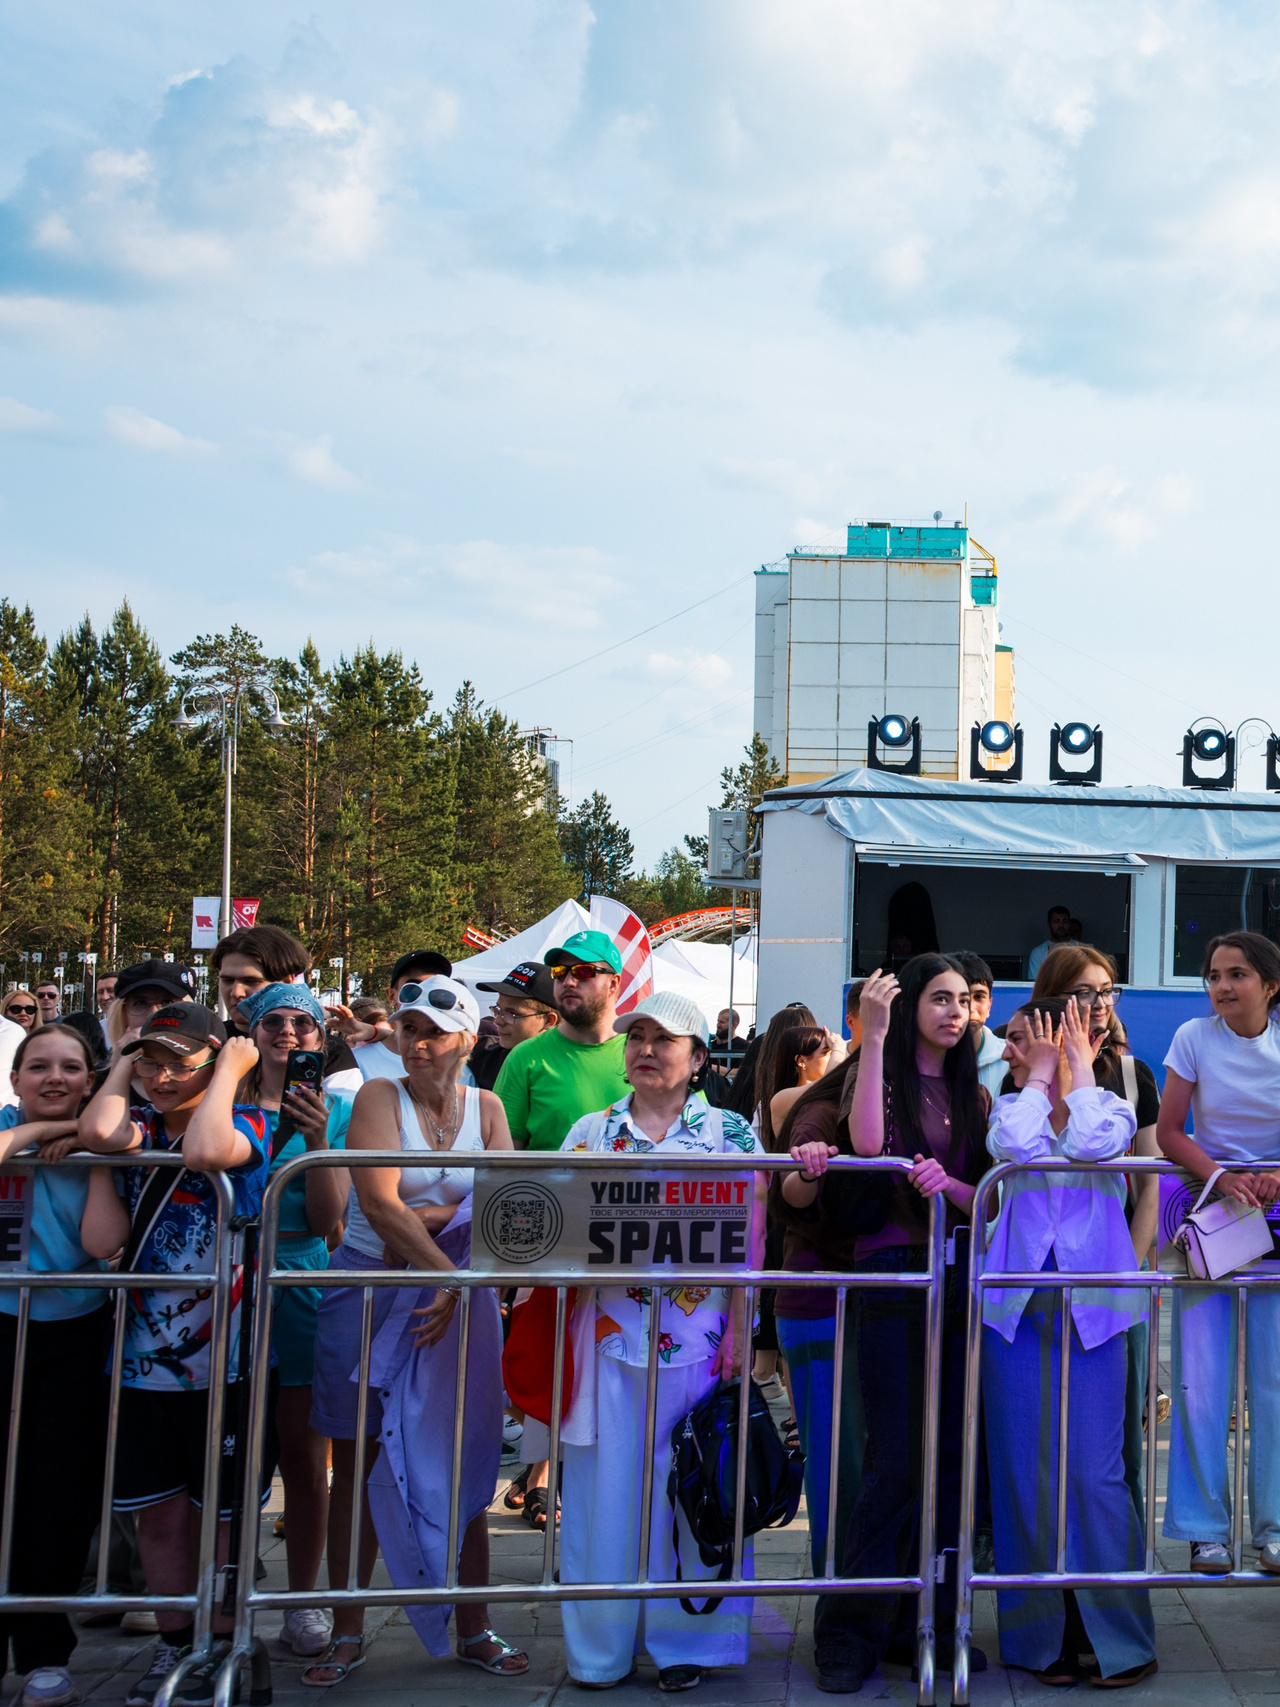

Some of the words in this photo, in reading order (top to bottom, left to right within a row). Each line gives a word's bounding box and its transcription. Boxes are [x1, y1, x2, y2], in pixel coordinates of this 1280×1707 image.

[590, 1181, 660, 1205] YOUR
[665, 1181, 748, 1204] EVENT
[590, 1208, 613, 1217] ТВОЕ
[615, 1208, 682, 1217] ПРОСТРАНСТВО
[683, 1207, 748, 1217] МЕРОПРИЯТИЙ
[588, 1221, 747, 1265] SPACE
